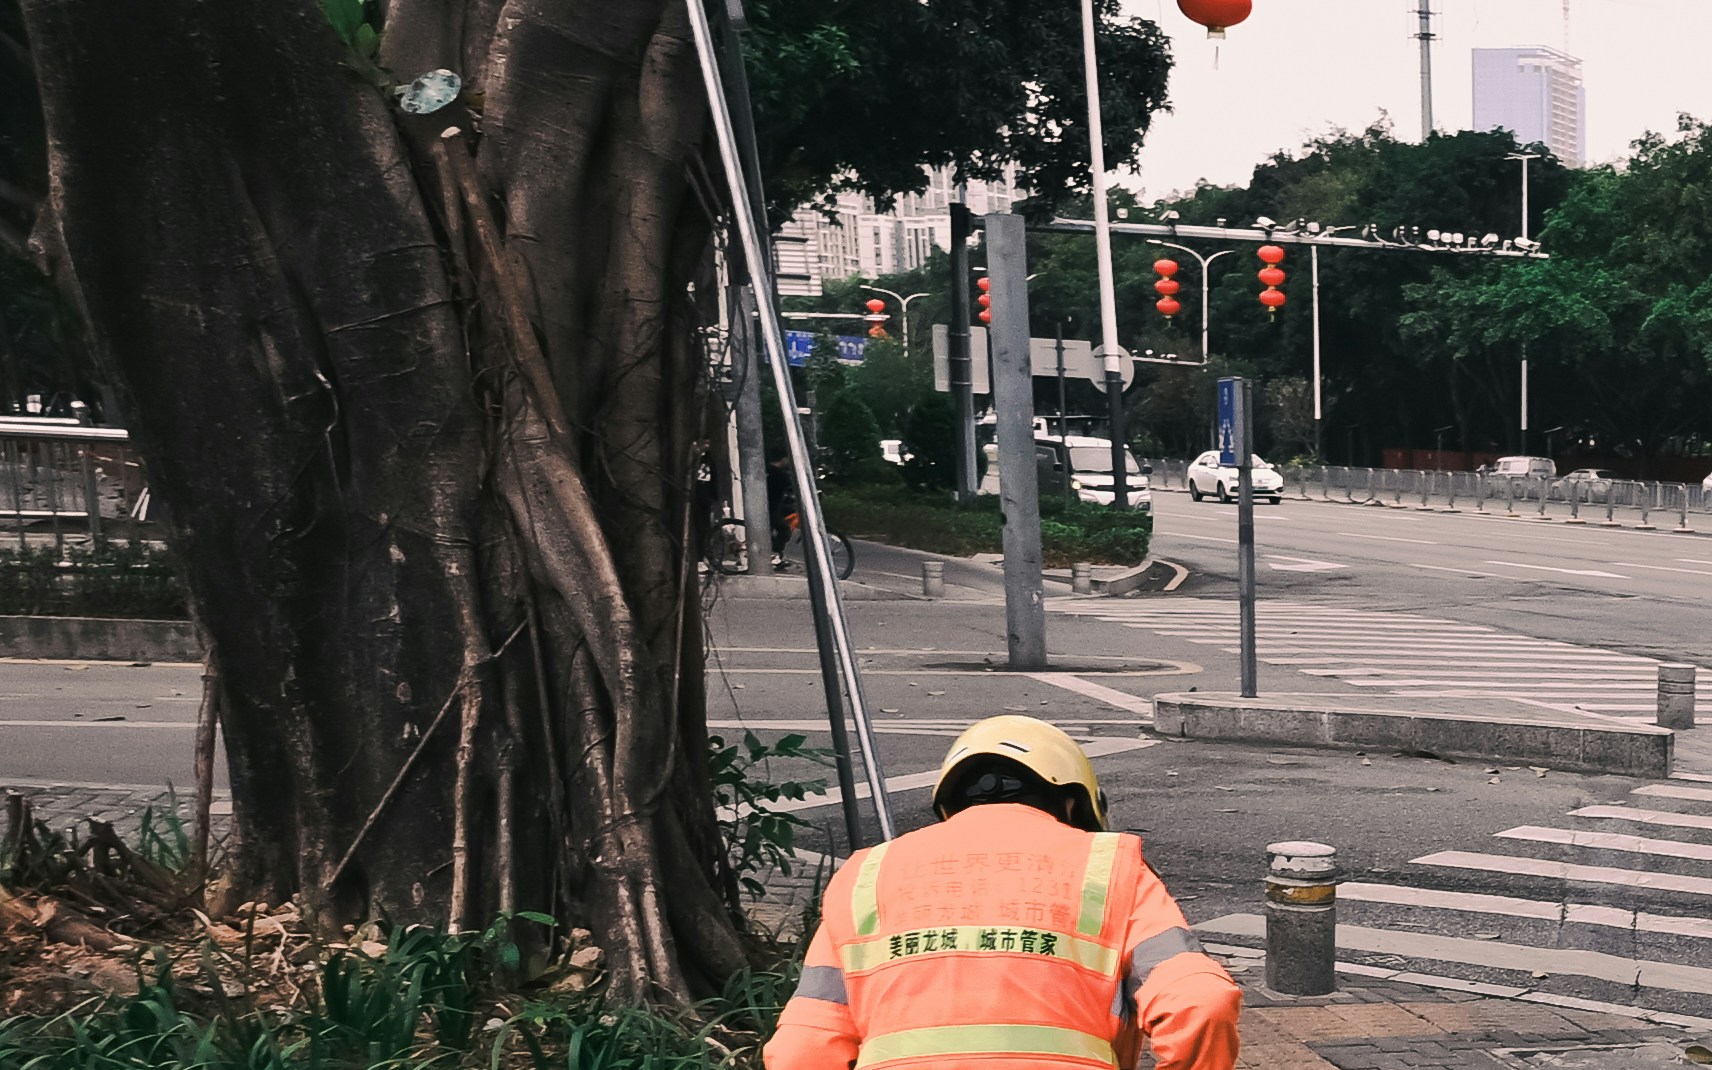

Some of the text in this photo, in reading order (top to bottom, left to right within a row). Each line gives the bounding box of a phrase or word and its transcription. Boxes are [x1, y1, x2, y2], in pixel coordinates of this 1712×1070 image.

[888, 927, 1058, 960] 美丽龙城 城市管家
